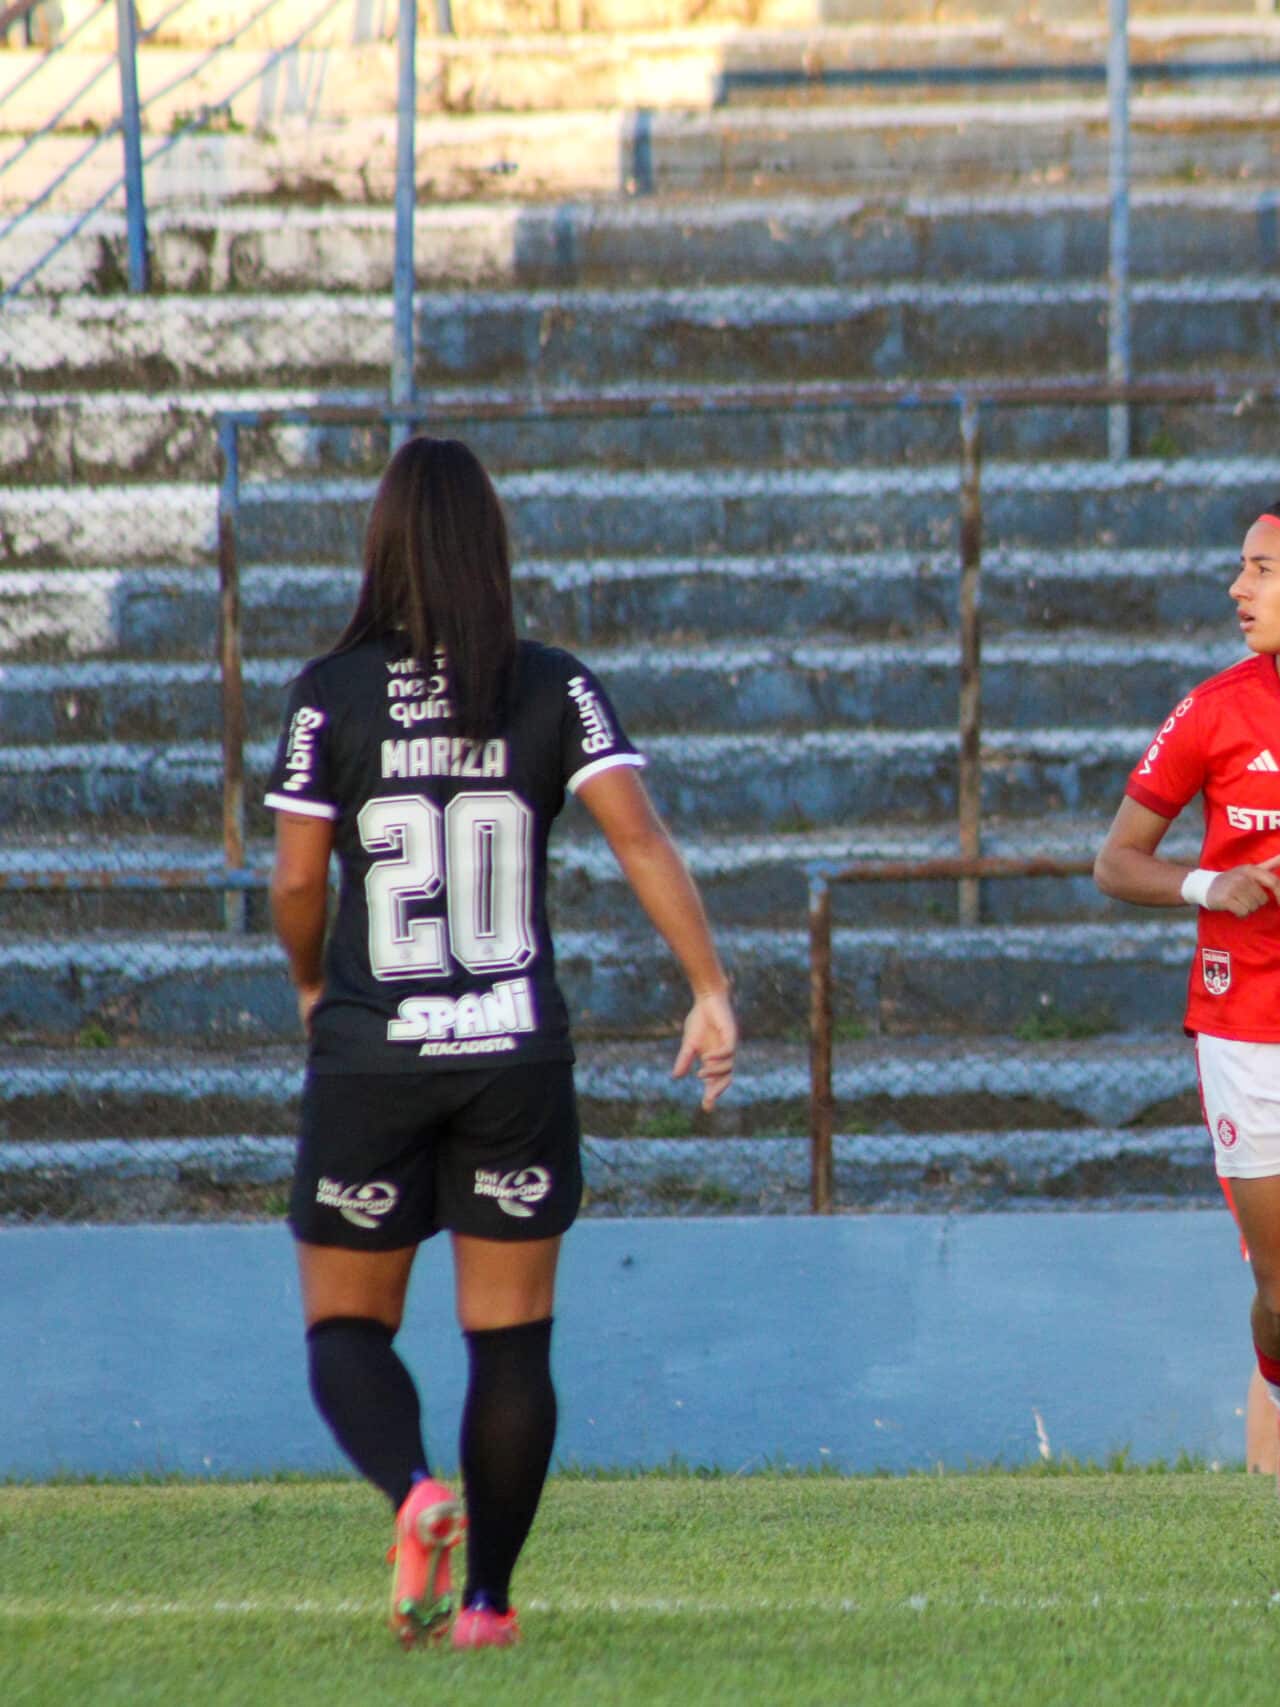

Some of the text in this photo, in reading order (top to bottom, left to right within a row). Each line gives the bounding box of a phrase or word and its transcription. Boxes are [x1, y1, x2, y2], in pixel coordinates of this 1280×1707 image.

[387, 675, 448, 698] neo
[285, 706, 325, 770] bmg
[575, 690, 614, 754] bmg
[381, 736, 505, 778] MARIZA
[357, 790, 536, 982] 20
[419, 1037, 515, 1057] ATACADISTA
[475, 1169, 498, 1184] Uni
